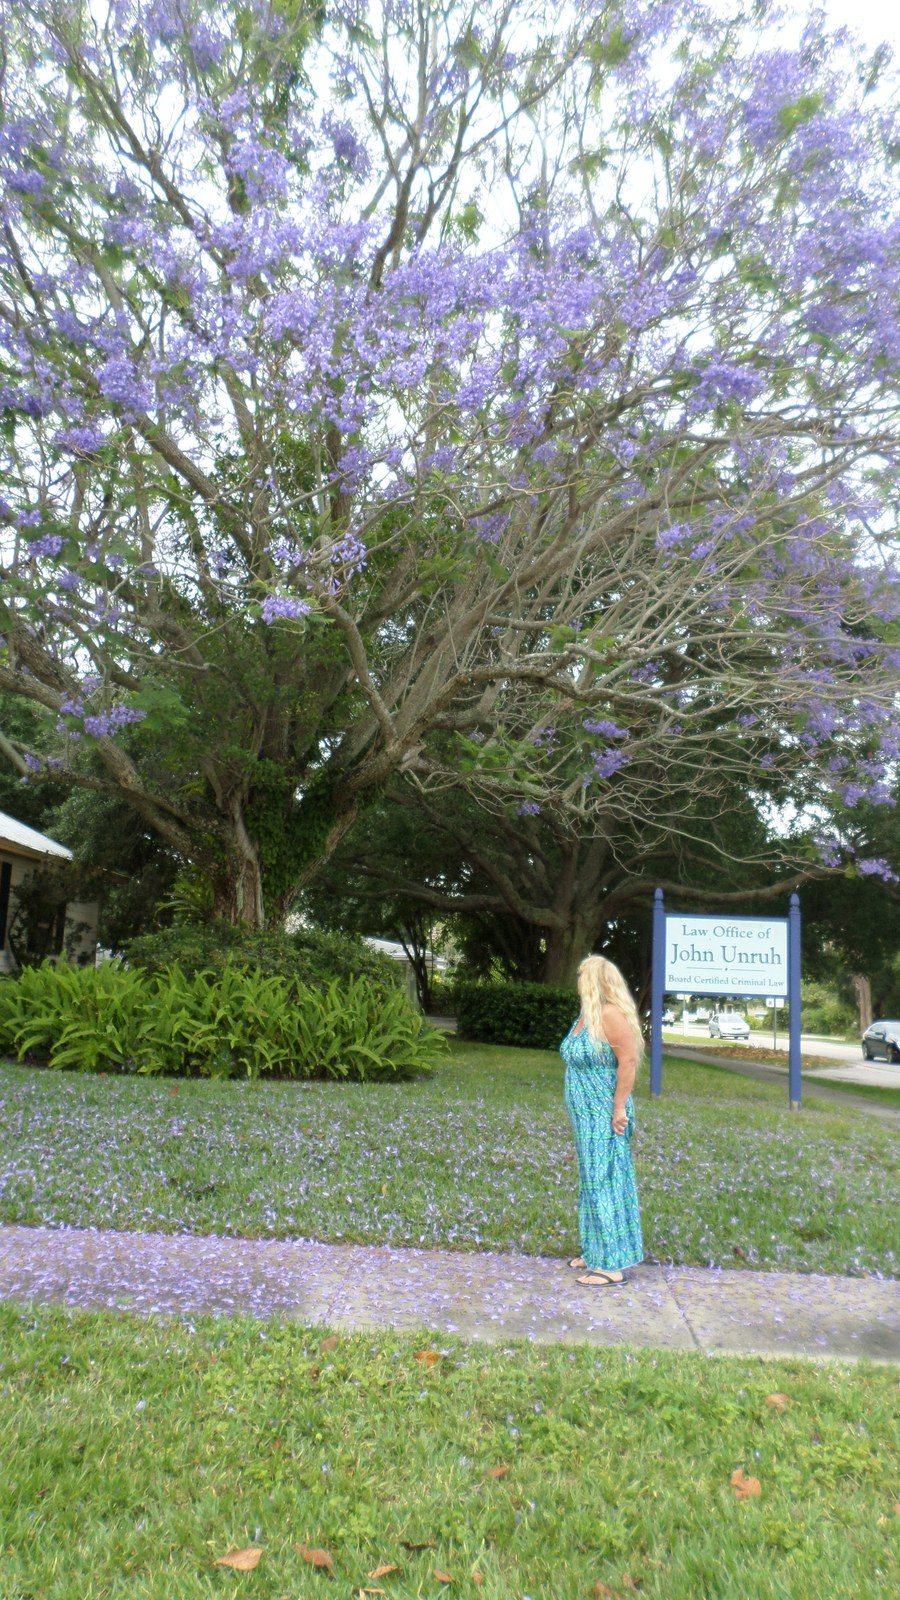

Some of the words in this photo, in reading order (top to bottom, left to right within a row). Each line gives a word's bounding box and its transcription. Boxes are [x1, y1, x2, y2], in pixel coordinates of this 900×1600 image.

[682, 925, 708, 936] Law
[713, 926, 753, 938] Office
[757, 928, 771, 939] of
[671, 943, 714, 964] John
[721, 945, 782, 965] Unruh
[668, 974, 692, 983] Board
[694, 976, 729, 985] Certified
[731, 978, 766, 986] Criminal
[768, 979, 784, 987] Law
